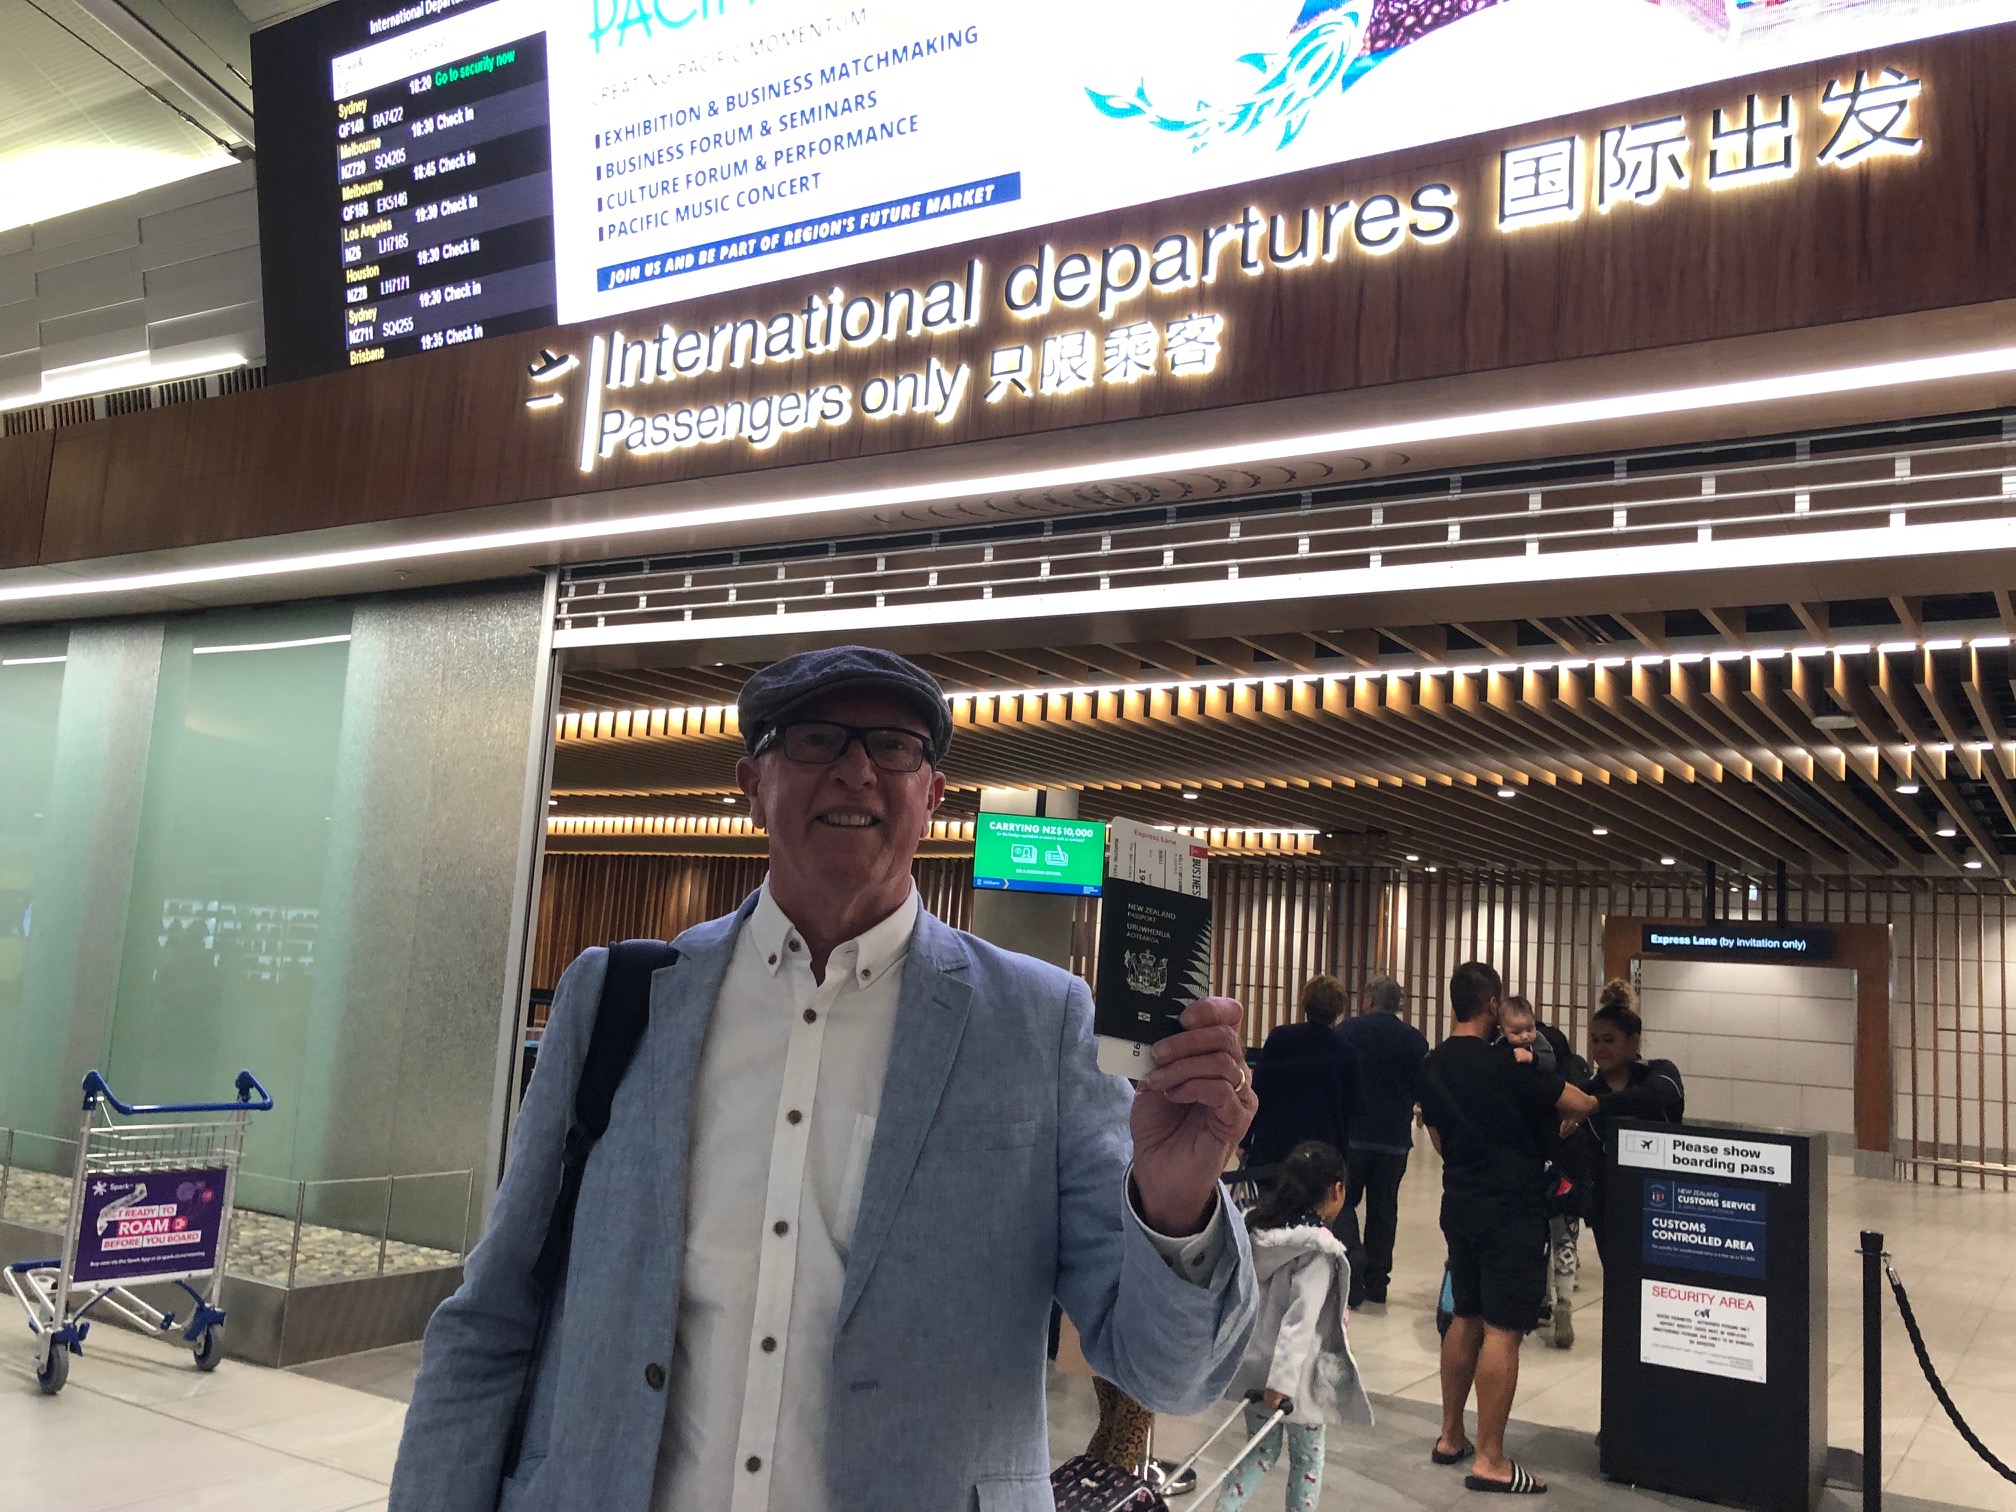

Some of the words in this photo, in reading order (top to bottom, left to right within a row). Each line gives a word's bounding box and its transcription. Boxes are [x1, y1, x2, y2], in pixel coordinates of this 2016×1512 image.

[369, 0, 425, 35] International
[750, 8, 867, 56] MOMENTUM
[409, 75, 433, 94] 18:20
[434, 70, 448, 86] Go
[449, 67, 459, 82] to
[460, 55, 495, 79] security
[496, 48, 516, 67] now
[604, 105, 701, 147] EXHIBITION
[707, 101, 720, 118] &
[725, 72, 814, 113] BUSINESS
[819, 25, 980, 86] MATCHMAKING
[338, 98, 368, 120] Sydney
[372, 106, 404, 129] BA7422
[436, 109, 465, 131] Check
[465, 106, 475, 122] in
[605, 145, 685, 180] BUSINESS
[689, 124, 754, 161] FORUM
[759, 120, 772, 138] &
[778, 90, 878, 132] SEMINARS
[340, 137, 382, 160] Melbourne
[374, 148, 407, 171] SQ4205
[1499, 66, 1923, 232] 国际出发
[412, 161, 437, 181] 18:45
[438, 153, 466, 174] Check
[466, 150, 477, 166] in
[606, 176, 680, 209] CULTURE
[685, 158, 749, 189] FORUM
[754, 155, 768, 173] &
[773, 114, 920, 167] PERFORMANCE
[342, 179, 384, 201] Melbourne
[440, 196, 469, 217] Check
[468, 194, 479, 209] in
[608, 210, 670, 240] PACIFIC
[675, 195, 730, 223] MUSIC
[736, 172, 822, 208] CONCERT
[343, 227, 359, 243] Los
[360, 218, 393, 239] Angeles
[608, 265, 641, 290] JOIN
[644, 261, 662, 278] US
[664, 253, 695, 273] AND
[698, 249, 716, 265] BE
[719, 239, 757, 261] PART
[760, 233, 780, 251] OF
[783, 217, 856, 247] REGION'S
[859, 202, 921, 231] FUTURE
[926, 184, 996, 216] MARKET
[442, 240, 470, 260] Check
[470, 238, 480, 253] in
[346, 265, 380, 283] Houston
[380, 275, 410, 295] LH7171
[444, 282, 471, 302] Check
[472, 281, 482, 296] in
[605, 258, 983, 390] International
[1004, 181, 1459, 318] departures
[348, 307, 378, 326] Sydney
[382, 316, 414, 337] SQ4255
[446, 325, 473, 345] Check
[473, 324, 483, 339] in
[350, 347, 385, 366] Brisbane
[984, 314, 1223, 403] 只限乘客
[599, 382, 848, 458] Passengers
[860, 357, 970, 424] only
[989, 821, 1040, 834] CARRYING
[1134, 829, 1160, 841] Express
[1161, 836, 1177, 846] Lane
[1192, 858, 1202, 896] BUSINES
[1127, 903, 1144, 912] NEW
[1144, 906, 1177, 920] ZEALAND
[1127, 911, 1157, 923] PASSPORT
[1126, 922, 1171, 939] URUWHENUA
[1650, 933, 1691, 947] Express
[1692, 934, 1718, 946] Lane
[1719, 936, 1735, 949] (by
[1736, 937, 1780, 948] invitation
[1782, 939, 1807, 951] only)
[1672, 1139, 1719, 1155] Please
[1723, 1145, 1761, 1159] show
[1672, 1153, 1736, 1173] boarding
[1740, 1162, 1775, 1175] pass
[1677, 1195, 1720, 1208] CUSTOMS
[1721, 1200, 1757, 1212] SERVICE
[1692, 1189, 1720, 1198] ZEALAND
[124, 1207, 157, 1218] READY
[161, 1205, 175, 1215] TO
[118, 1218, 170, 1236] ROAM
[1651, 1217, 1707, 1234] CUSTOMS
[103, 1238, 141, 1249] BEFORE
[145, 1235, 166, 1245] YOU
[166, 1232, 199, 1243] BOARD
[1651, 1229, 1723, 1247] CONTROLLED
[1724, 1239, 1755, 1252] AREA
[1651, 1285, 1716, 1306] SECURITY
[1719, 1296, 1755, 1311] AREA
